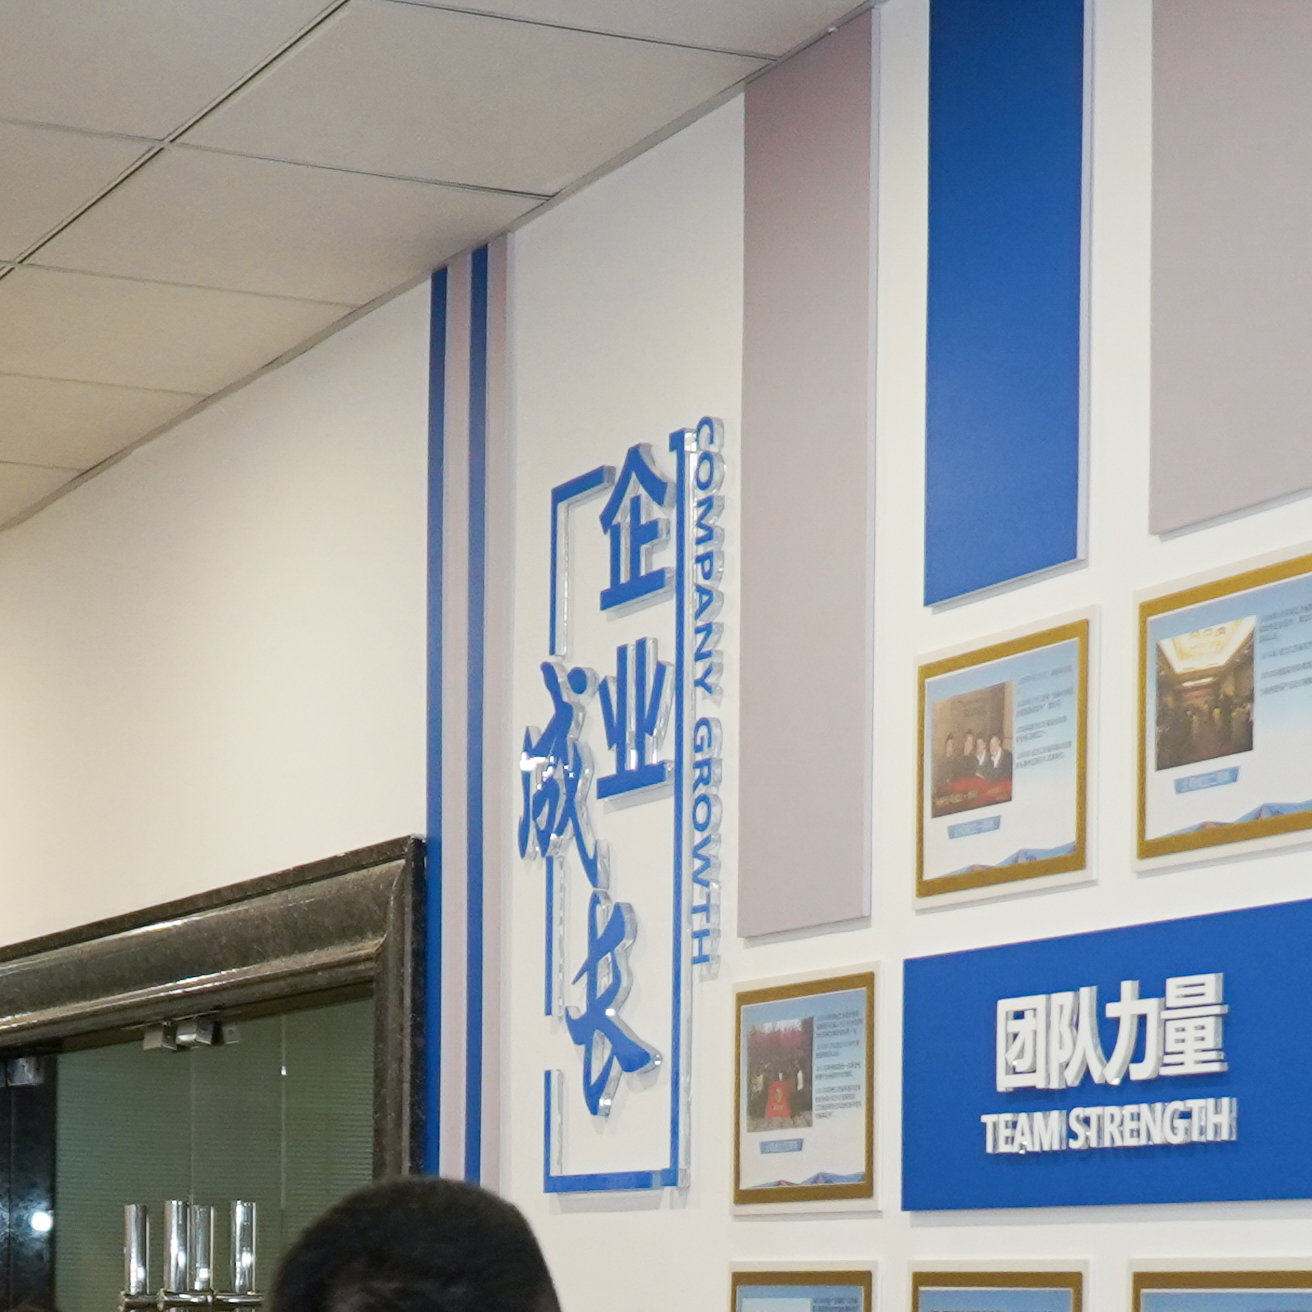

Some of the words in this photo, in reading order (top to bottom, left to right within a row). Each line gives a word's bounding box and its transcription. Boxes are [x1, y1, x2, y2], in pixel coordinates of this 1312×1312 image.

[694, 416, 719, 700] COMPANY
[691, 716, 716, 968] GROWTH
[996, 972, 1229, 1092] 团队力量
[980, 1109, 1067, 1155] TEAM
[1069, 1096, 1238, 1150] STRENGTH
